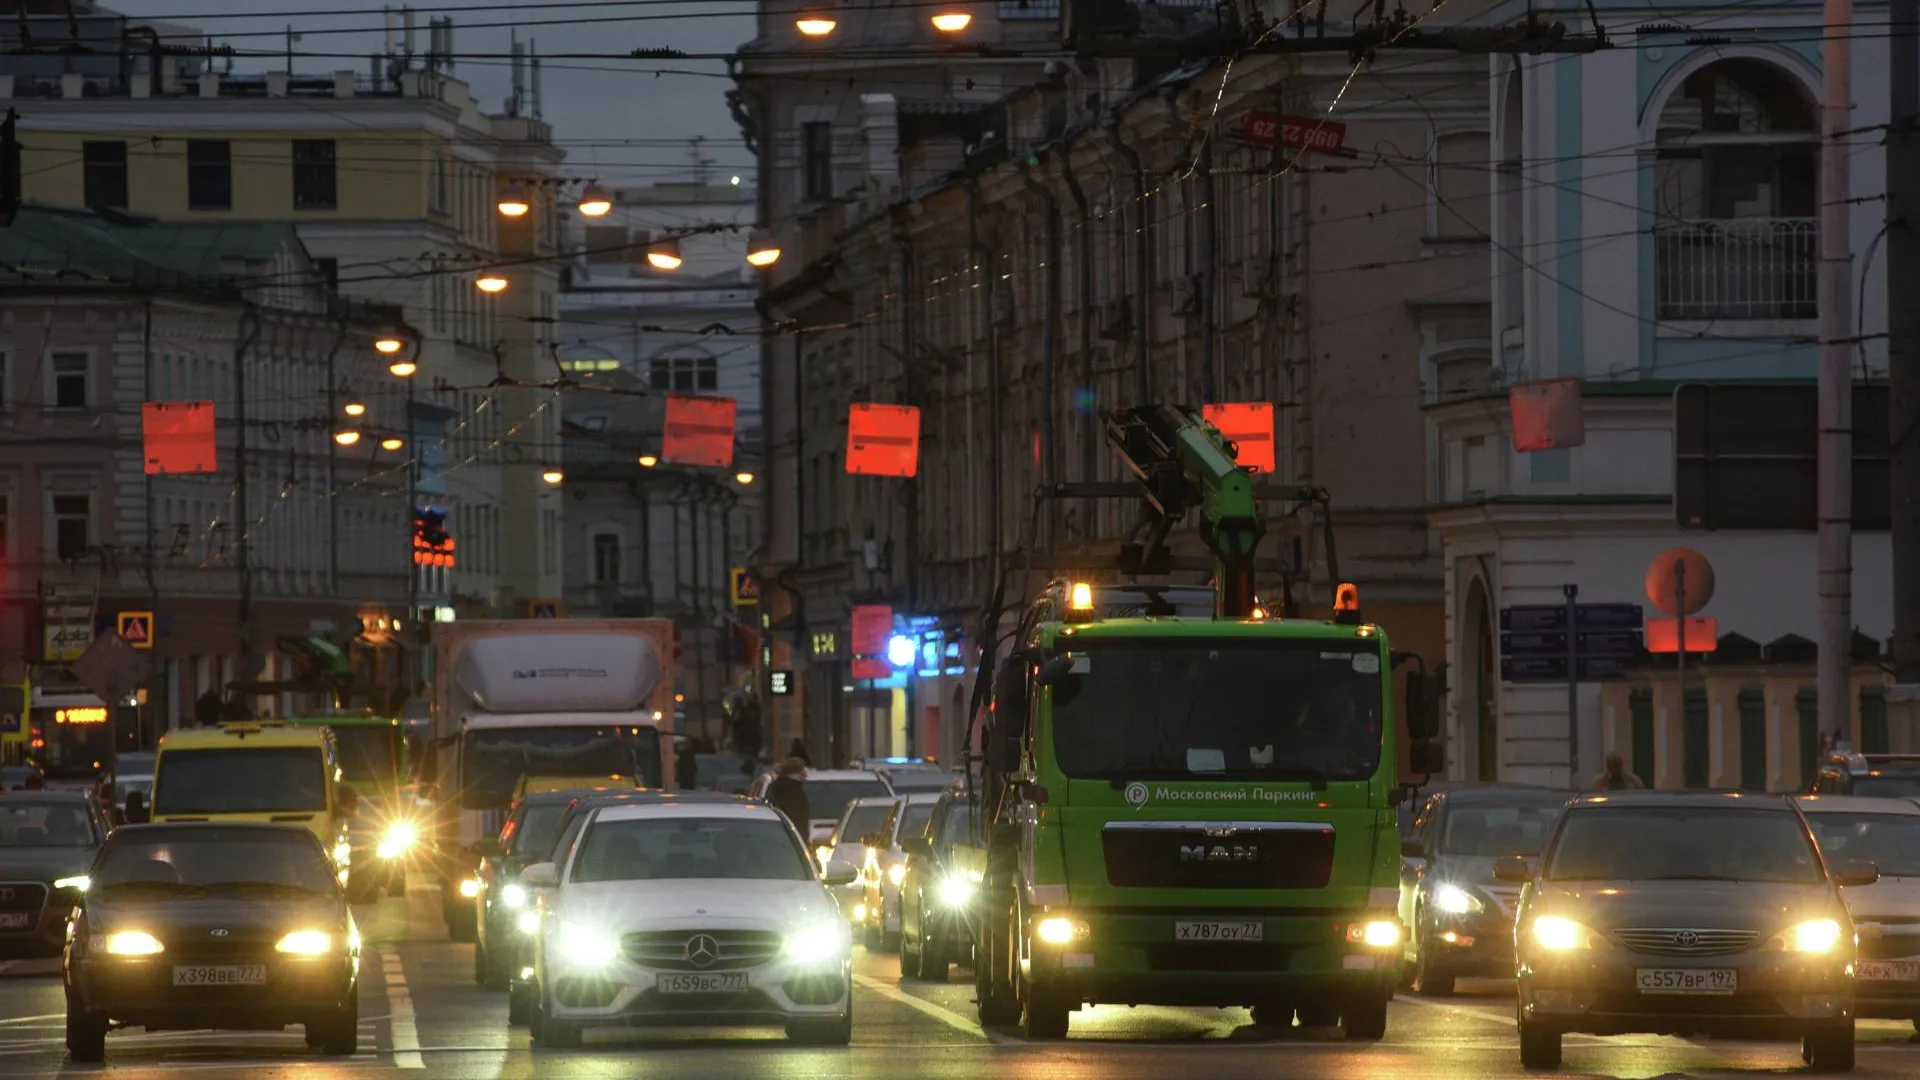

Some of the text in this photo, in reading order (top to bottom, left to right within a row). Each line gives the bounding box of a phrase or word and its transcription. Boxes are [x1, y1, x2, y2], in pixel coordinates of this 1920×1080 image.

[1155, 787, 1316, 804] Московский Паркинг
[1180, 845, 1258, 861] MAN
